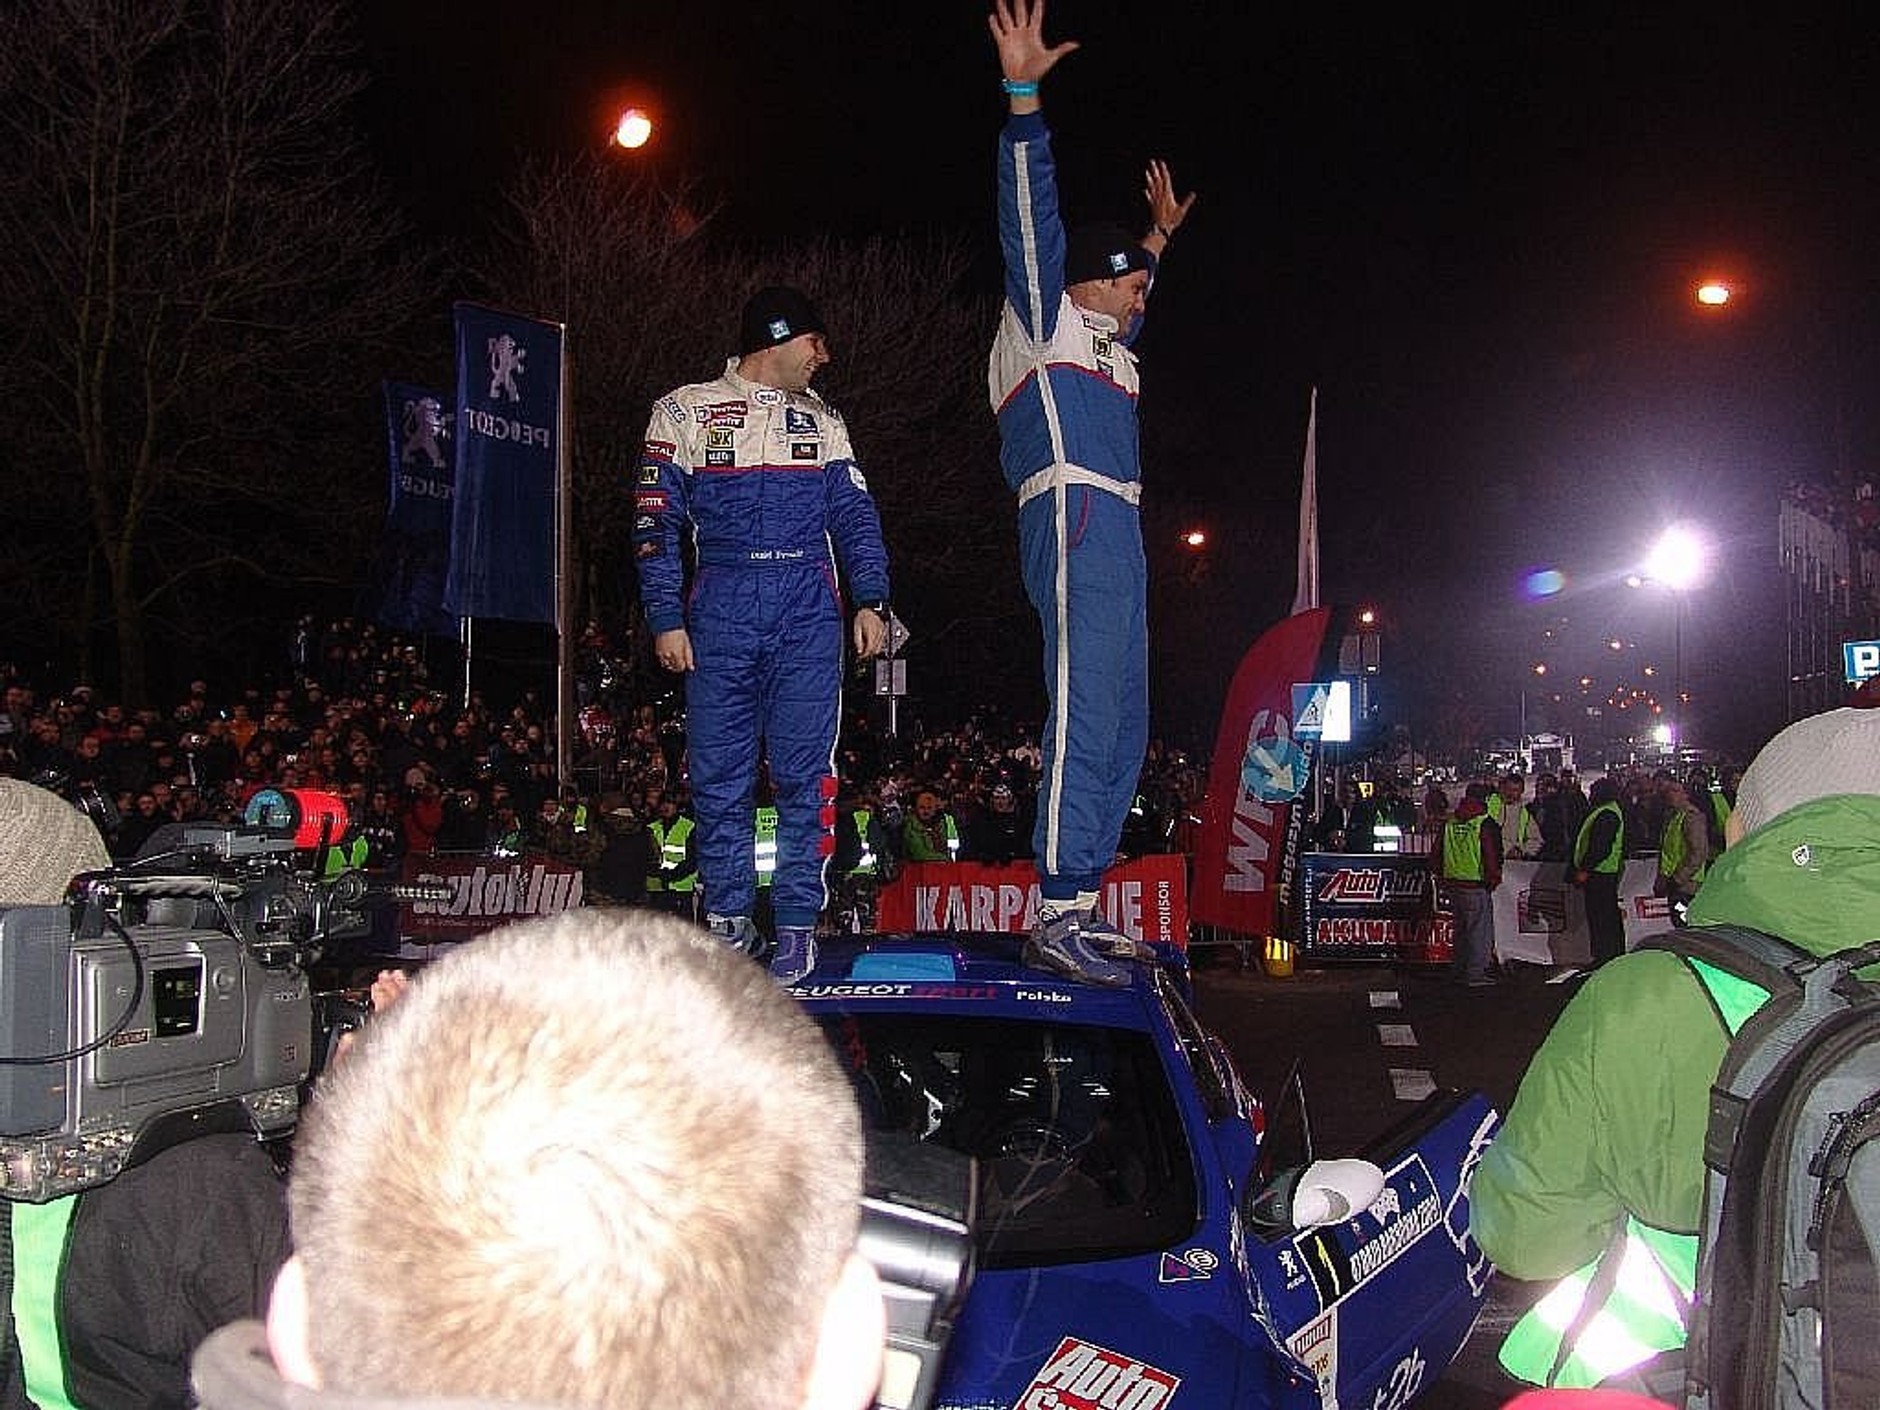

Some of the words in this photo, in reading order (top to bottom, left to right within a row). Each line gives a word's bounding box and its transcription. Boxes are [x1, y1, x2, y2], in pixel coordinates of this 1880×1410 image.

[1852, 646, 1880, 677] P
[915, 881, 1144, 941] KARPAIE
[1158, 881, 1171, 942] SPONSOR
